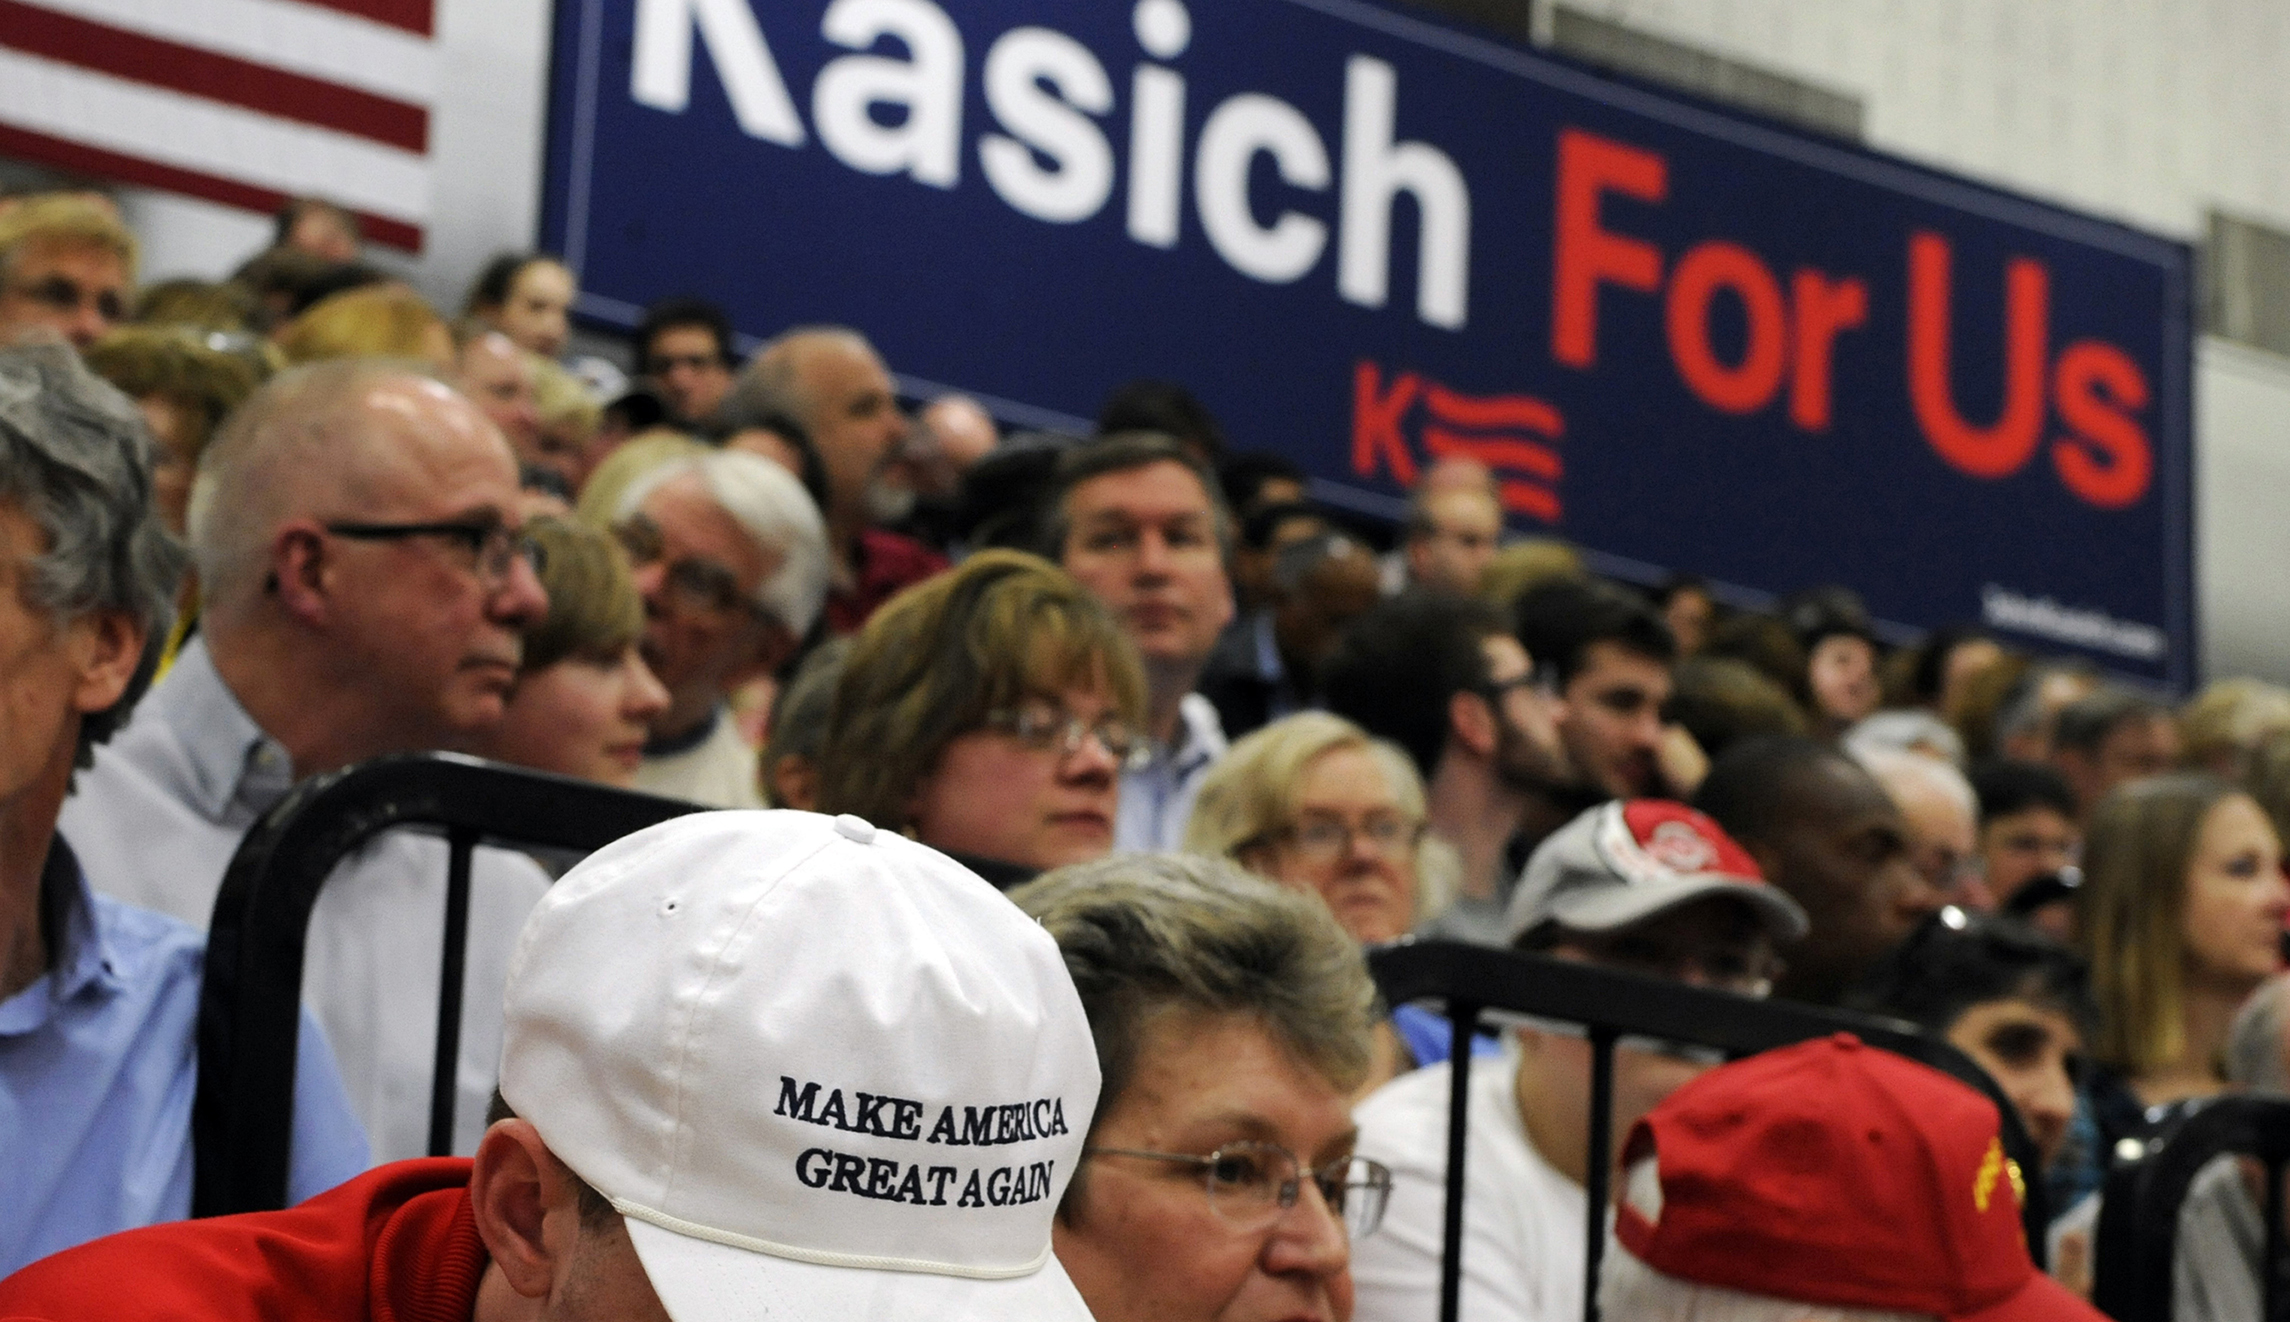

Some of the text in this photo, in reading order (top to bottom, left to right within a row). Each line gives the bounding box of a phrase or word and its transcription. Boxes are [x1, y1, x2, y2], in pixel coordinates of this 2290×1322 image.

[1550, 130, 1868, 433] For
[1908, 232, 2152, 508] Us
[773, 1075, 1068, 1146] MAKE AMERICA
[795, 1147, 1054, 1208] GREAT AGAIN
